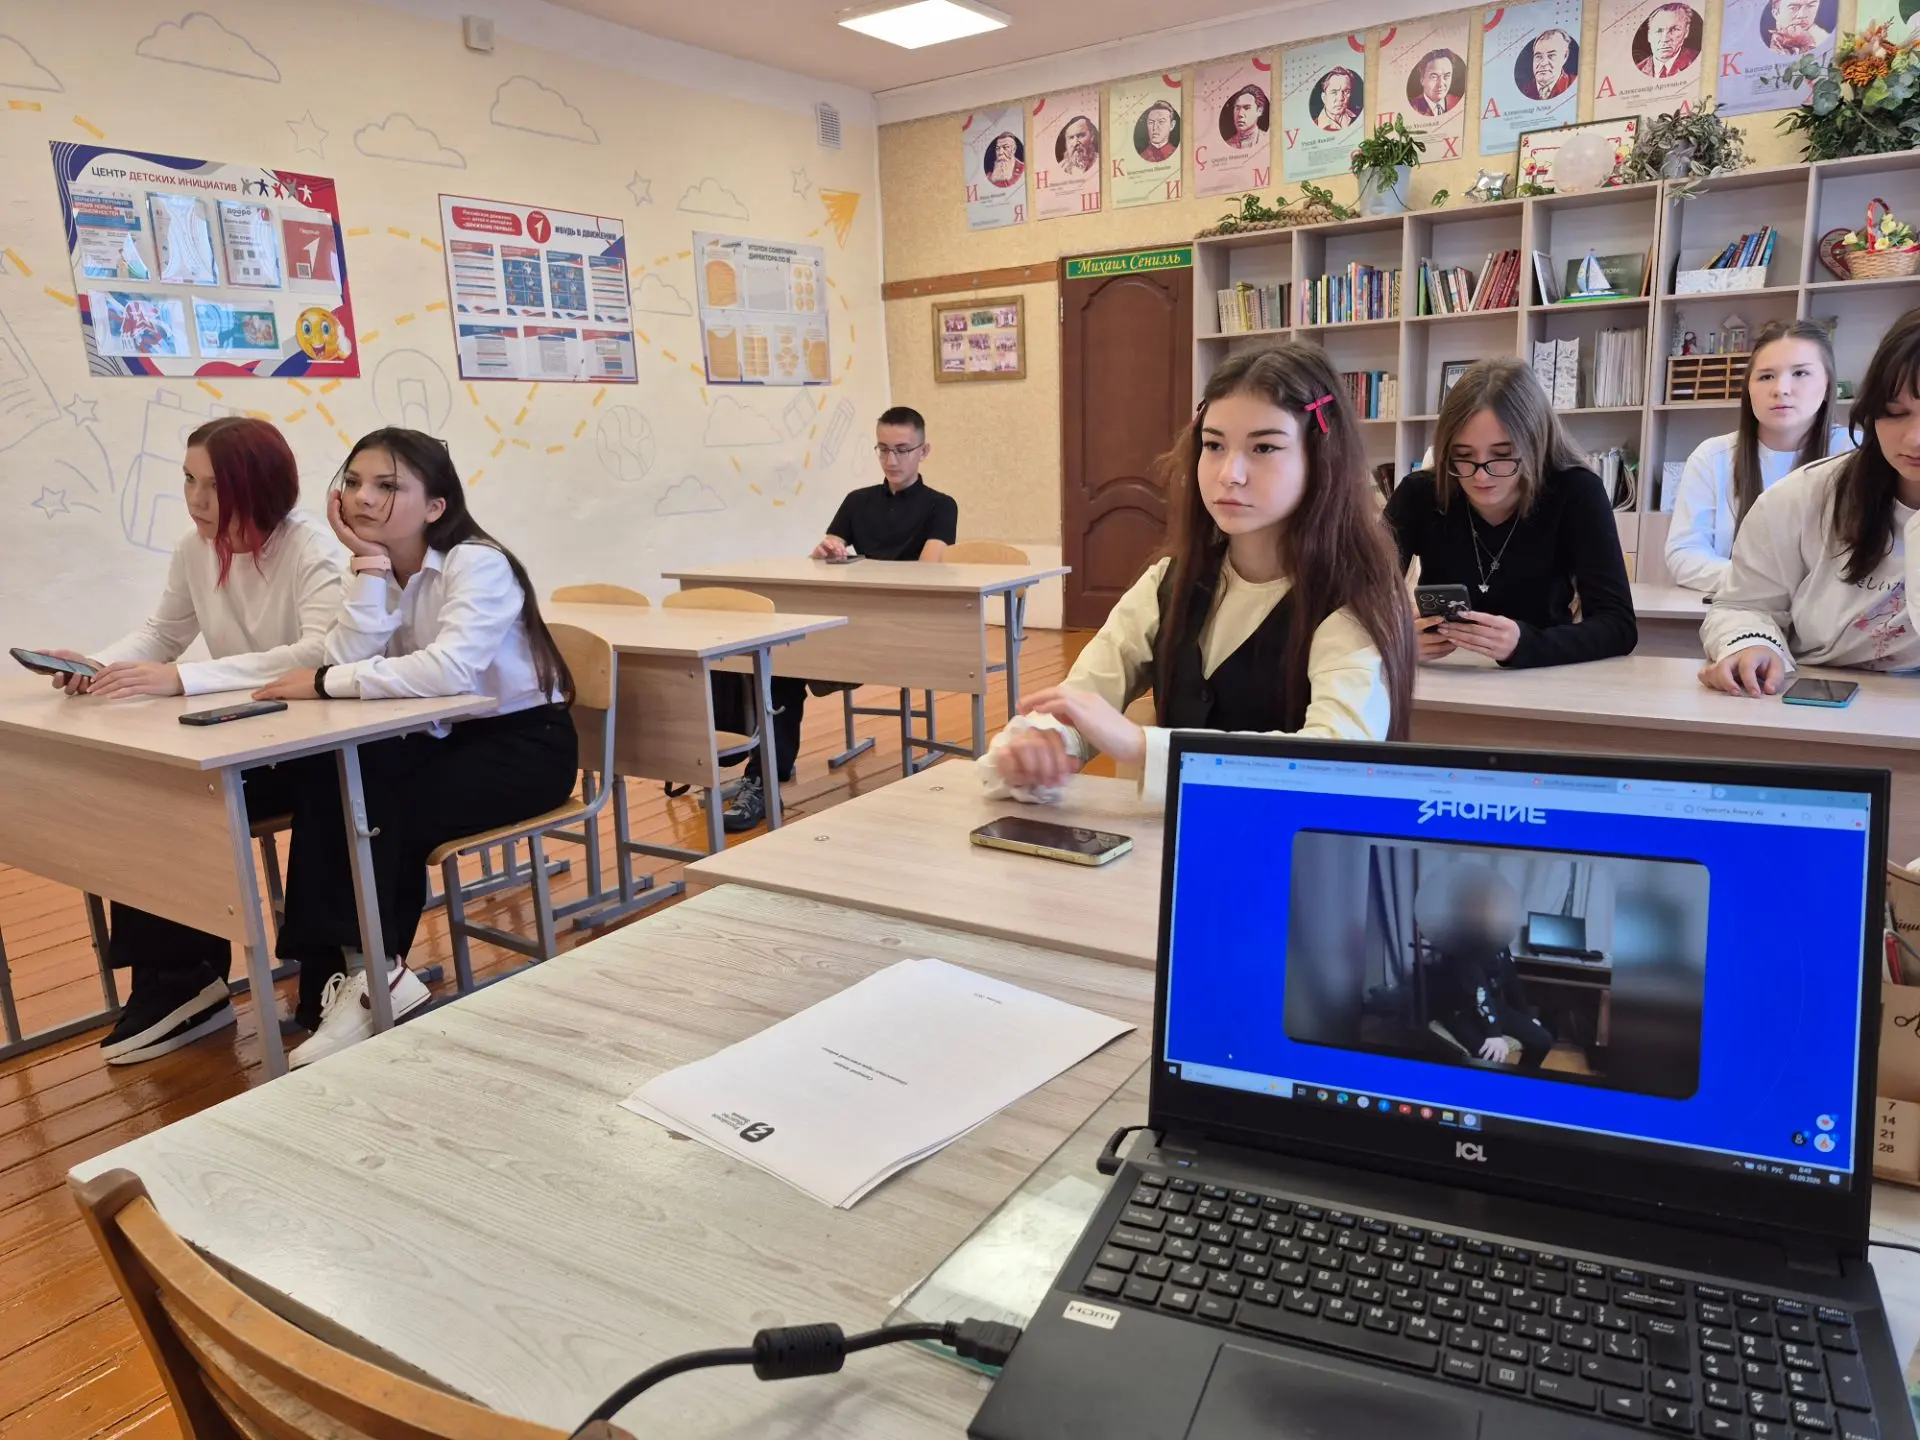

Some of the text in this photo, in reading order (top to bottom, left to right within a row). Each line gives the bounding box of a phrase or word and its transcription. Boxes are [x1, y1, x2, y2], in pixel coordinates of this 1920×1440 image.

[1720, 52, 1744, 77] К
[1112, 158, 1125, 178] К
[1253, 167, 1270, 187] М
[92, 167, 237, 192] ЦЕНТР ДЕТСКИХ ИНИЦИАТИВ
[1036, 171, 1049, 189] Н
[966, 184, 979, 203] И
[1166, 180, 1181, 200] И
[1081, 192, 1100, 211] Ш
[1014, 204, 1024, 222] Я
[1078, 253, 1181, 274] Михаил Сениэль
[1888, 1102, 1897, 1111] 7
[1882, 1115, 1896, 1126] 14
[1880, 1128, 1895, 1139] 21
[1456, 1141, 1487, 1162] ICL
[1878, 1142, 1894, 1153] 28
